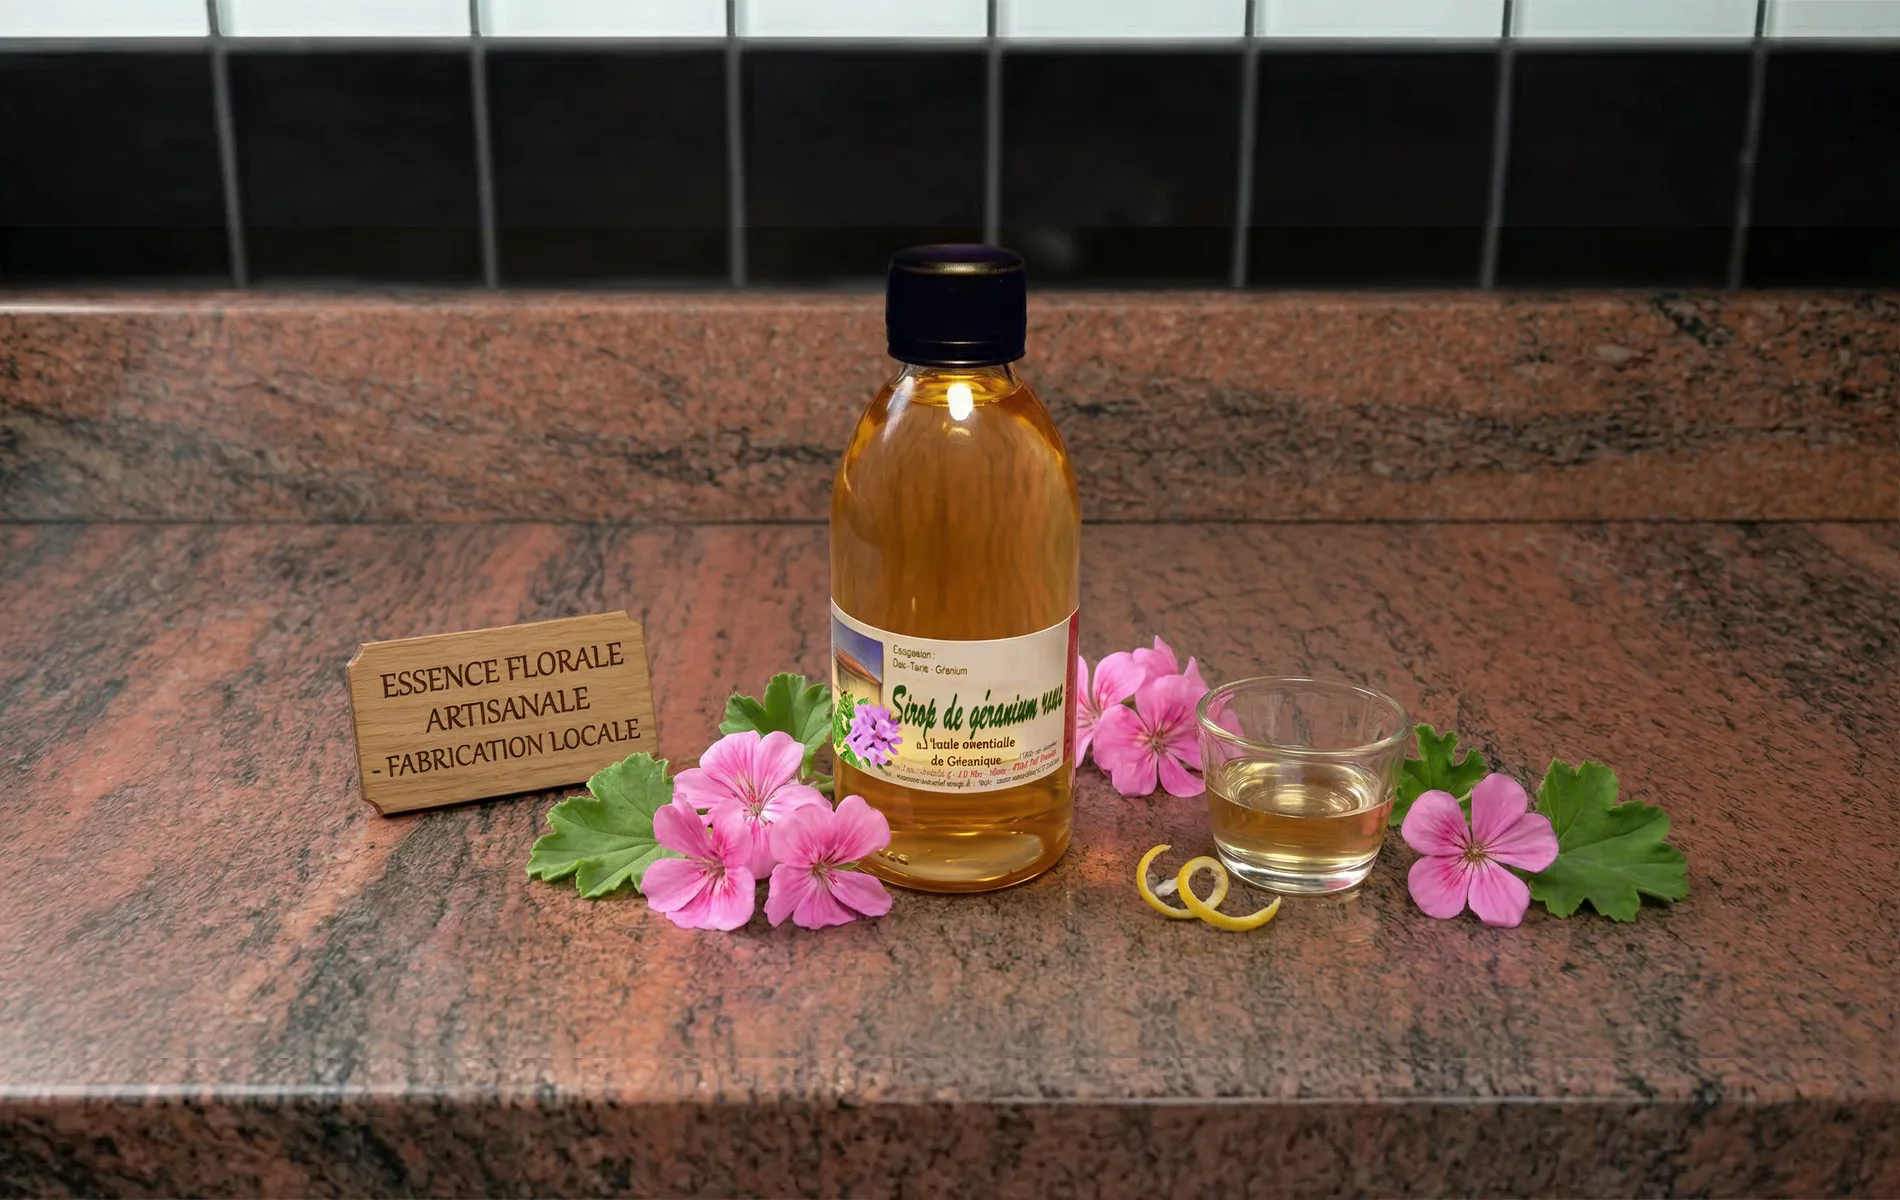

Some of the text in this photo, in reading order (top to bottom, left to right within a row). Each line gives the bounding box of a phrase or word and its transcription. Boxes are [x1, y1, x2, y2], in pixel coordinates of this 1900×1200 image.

[380, 641, 624, 699] ESSENCE FLORALE
[425, 686, 591, 734] ARTISANALE
[892, 684, 937, 739] Sirop
[943, 693, 963, 731] de
[969, 689, 1038, 740] géranium
[386, 733, 544, 778] FABRICATION
[548, 718, 642, 752] LOCALE
[931, 754, 944, 766] de
